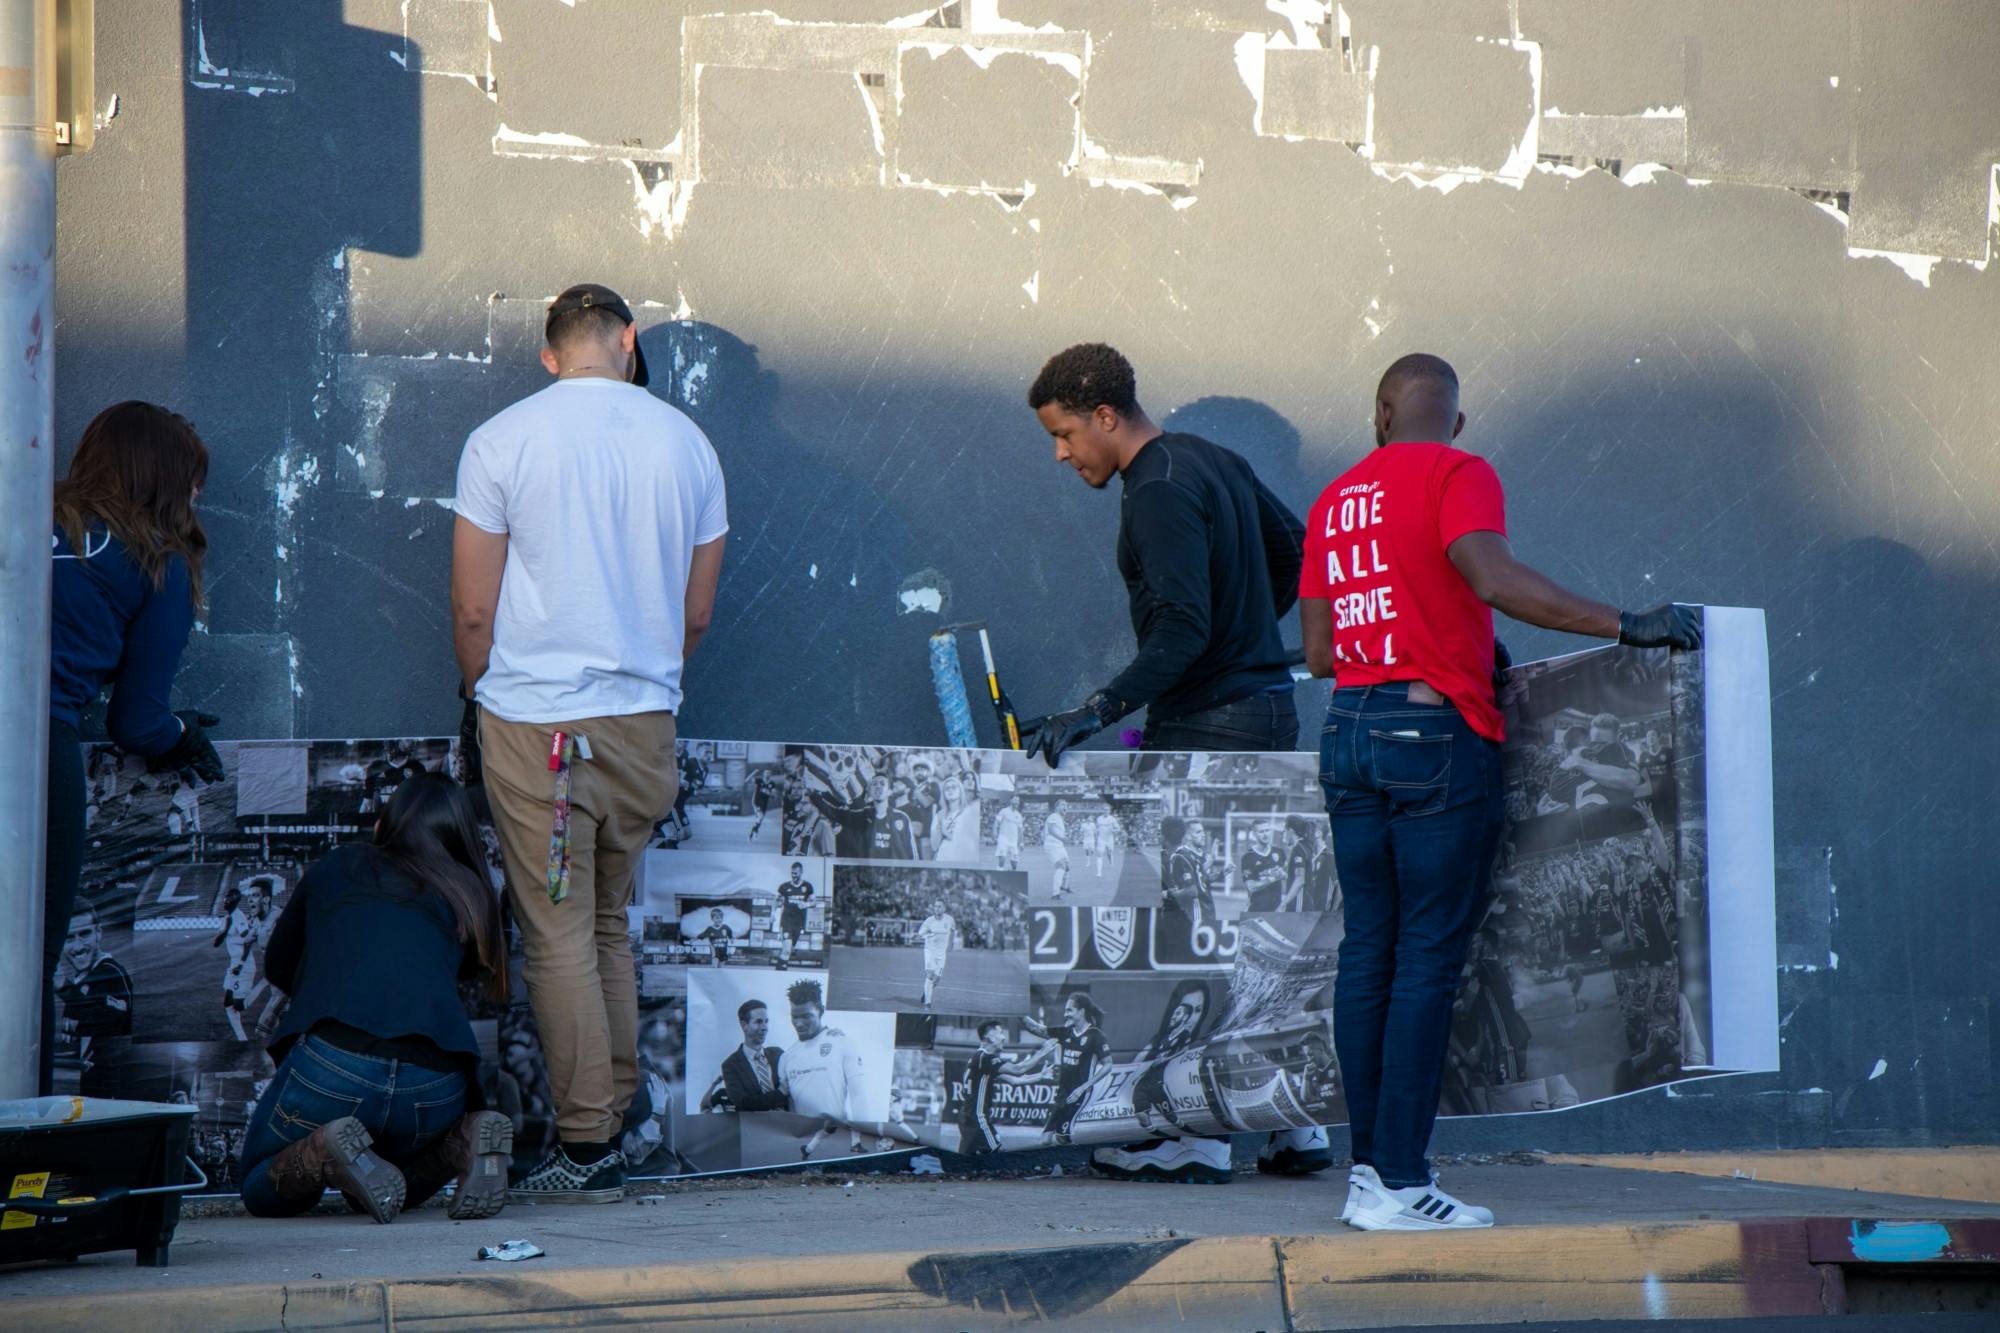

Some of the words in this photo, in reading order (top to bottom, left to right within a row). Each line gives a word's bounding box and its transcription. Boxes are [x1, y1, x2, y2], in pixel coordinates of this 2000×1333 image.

[1325, 490, 1384, 538] LOVE
[1327, 539, 1389, 586] ALL
[1034, 910, 1058, 955] 2
[1101, 910, 1128, 922] UNITED
[1010, 1107, 1048, 1120] UNION
